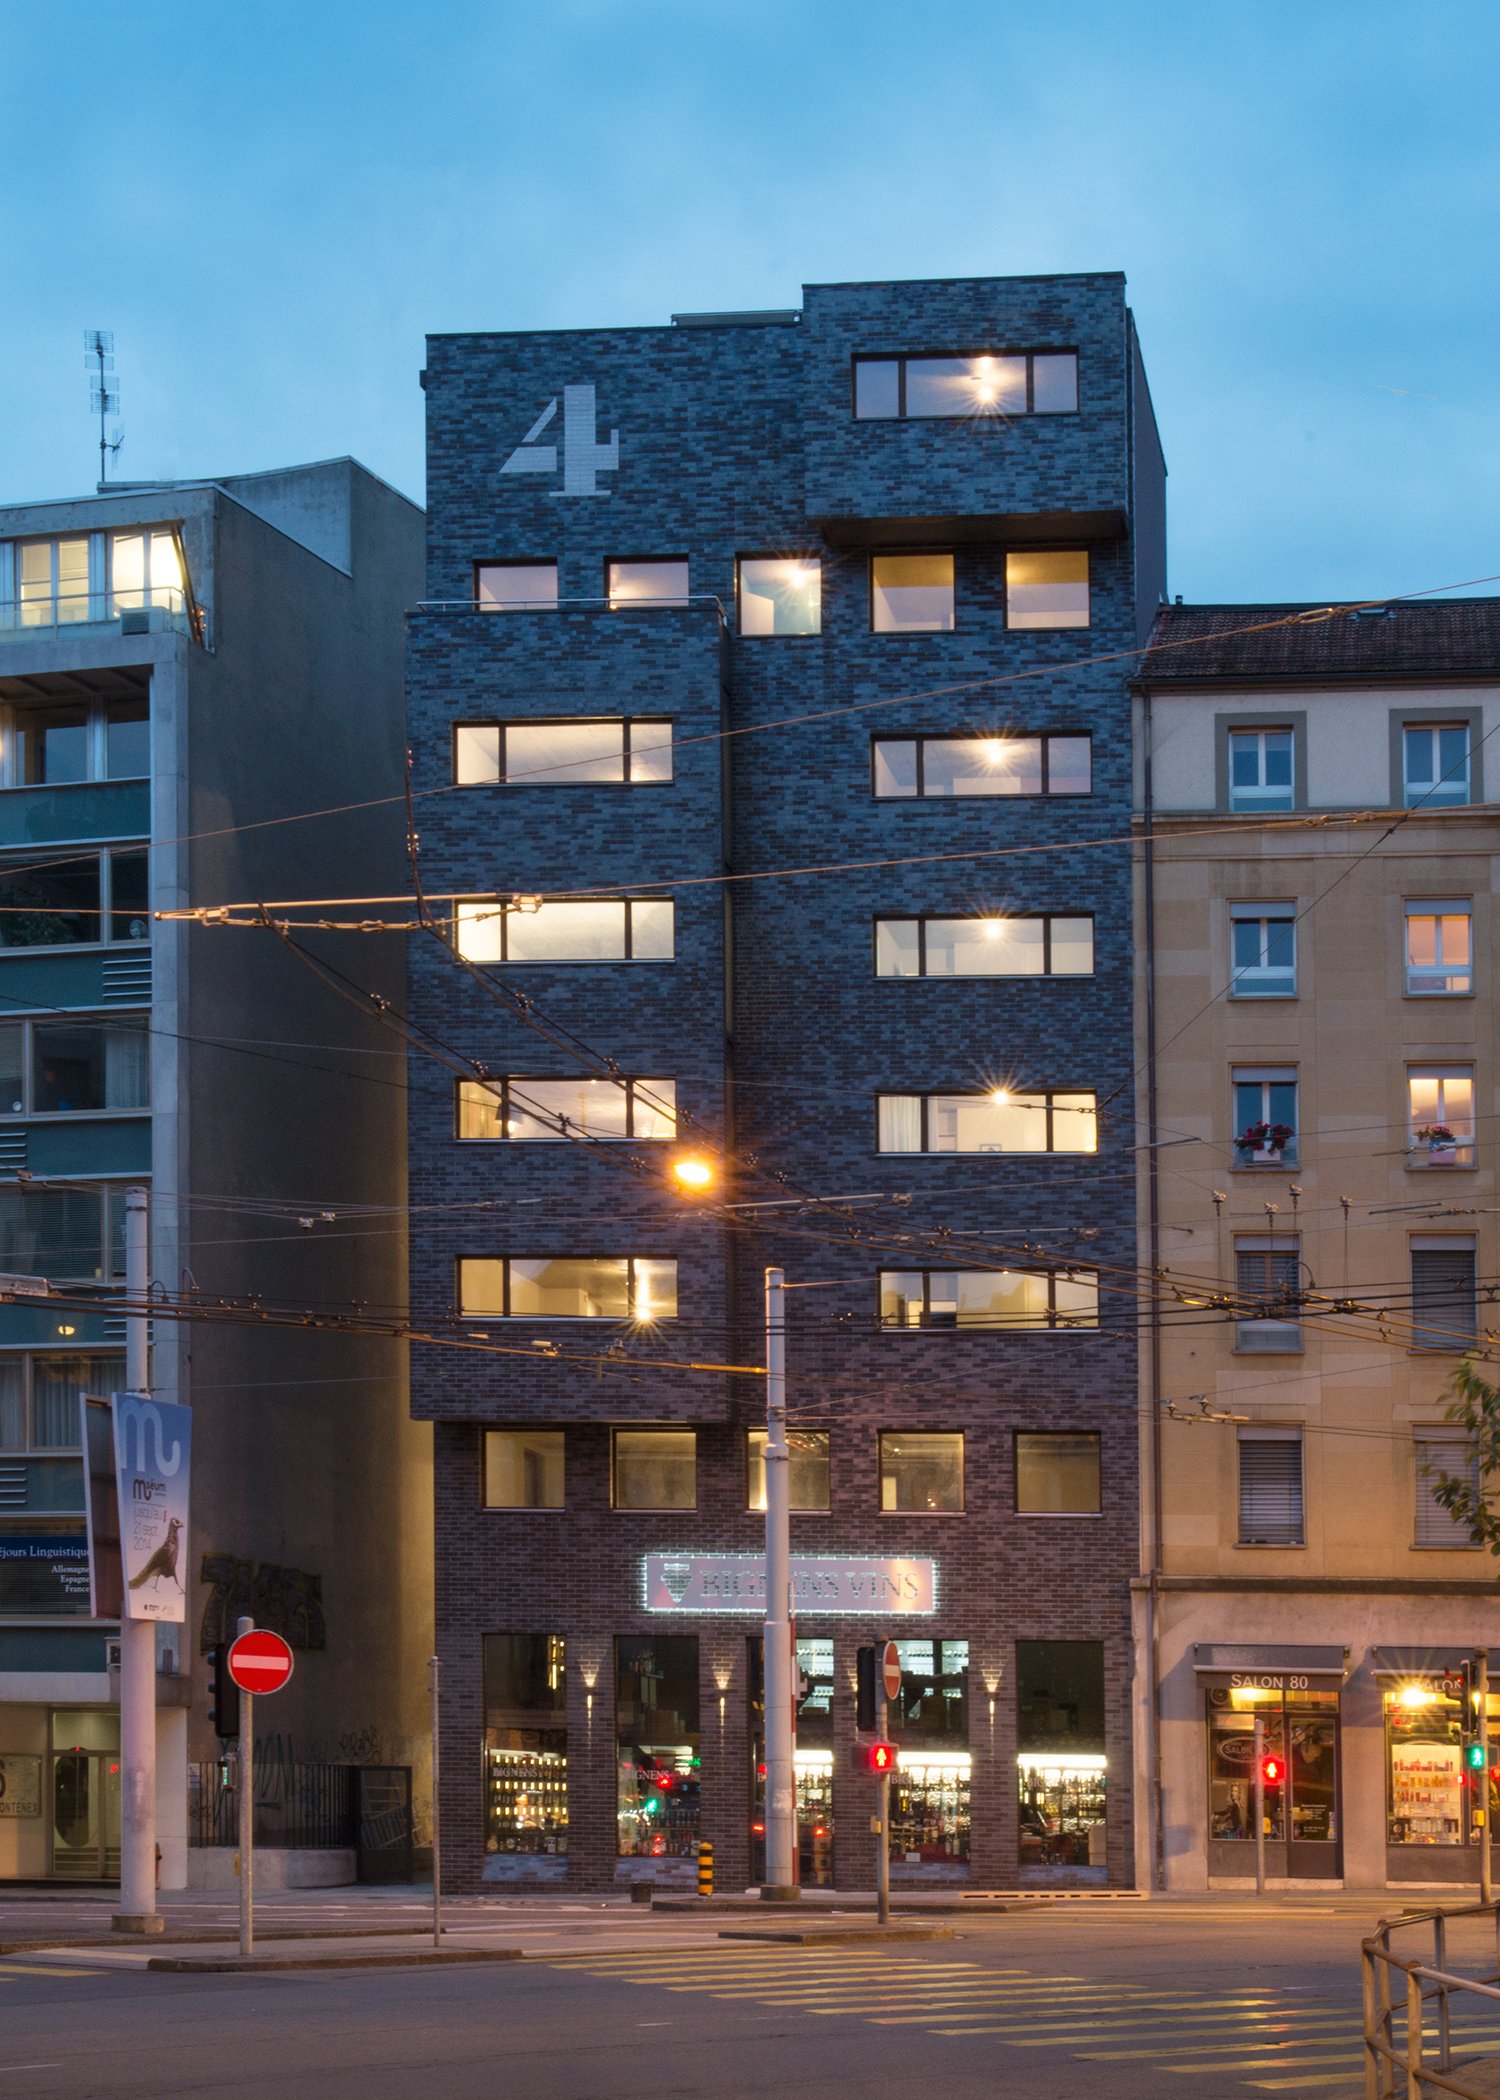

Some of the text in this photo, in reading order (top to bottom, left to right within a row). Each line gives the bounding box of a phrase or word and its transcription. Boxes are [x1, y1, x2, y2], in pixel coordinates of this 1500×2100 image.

[500, 385, 619, 496] 4
[846, 1571, 919, 1600] VINS
[1231, 1674, 1309, 1690] SALON 80
